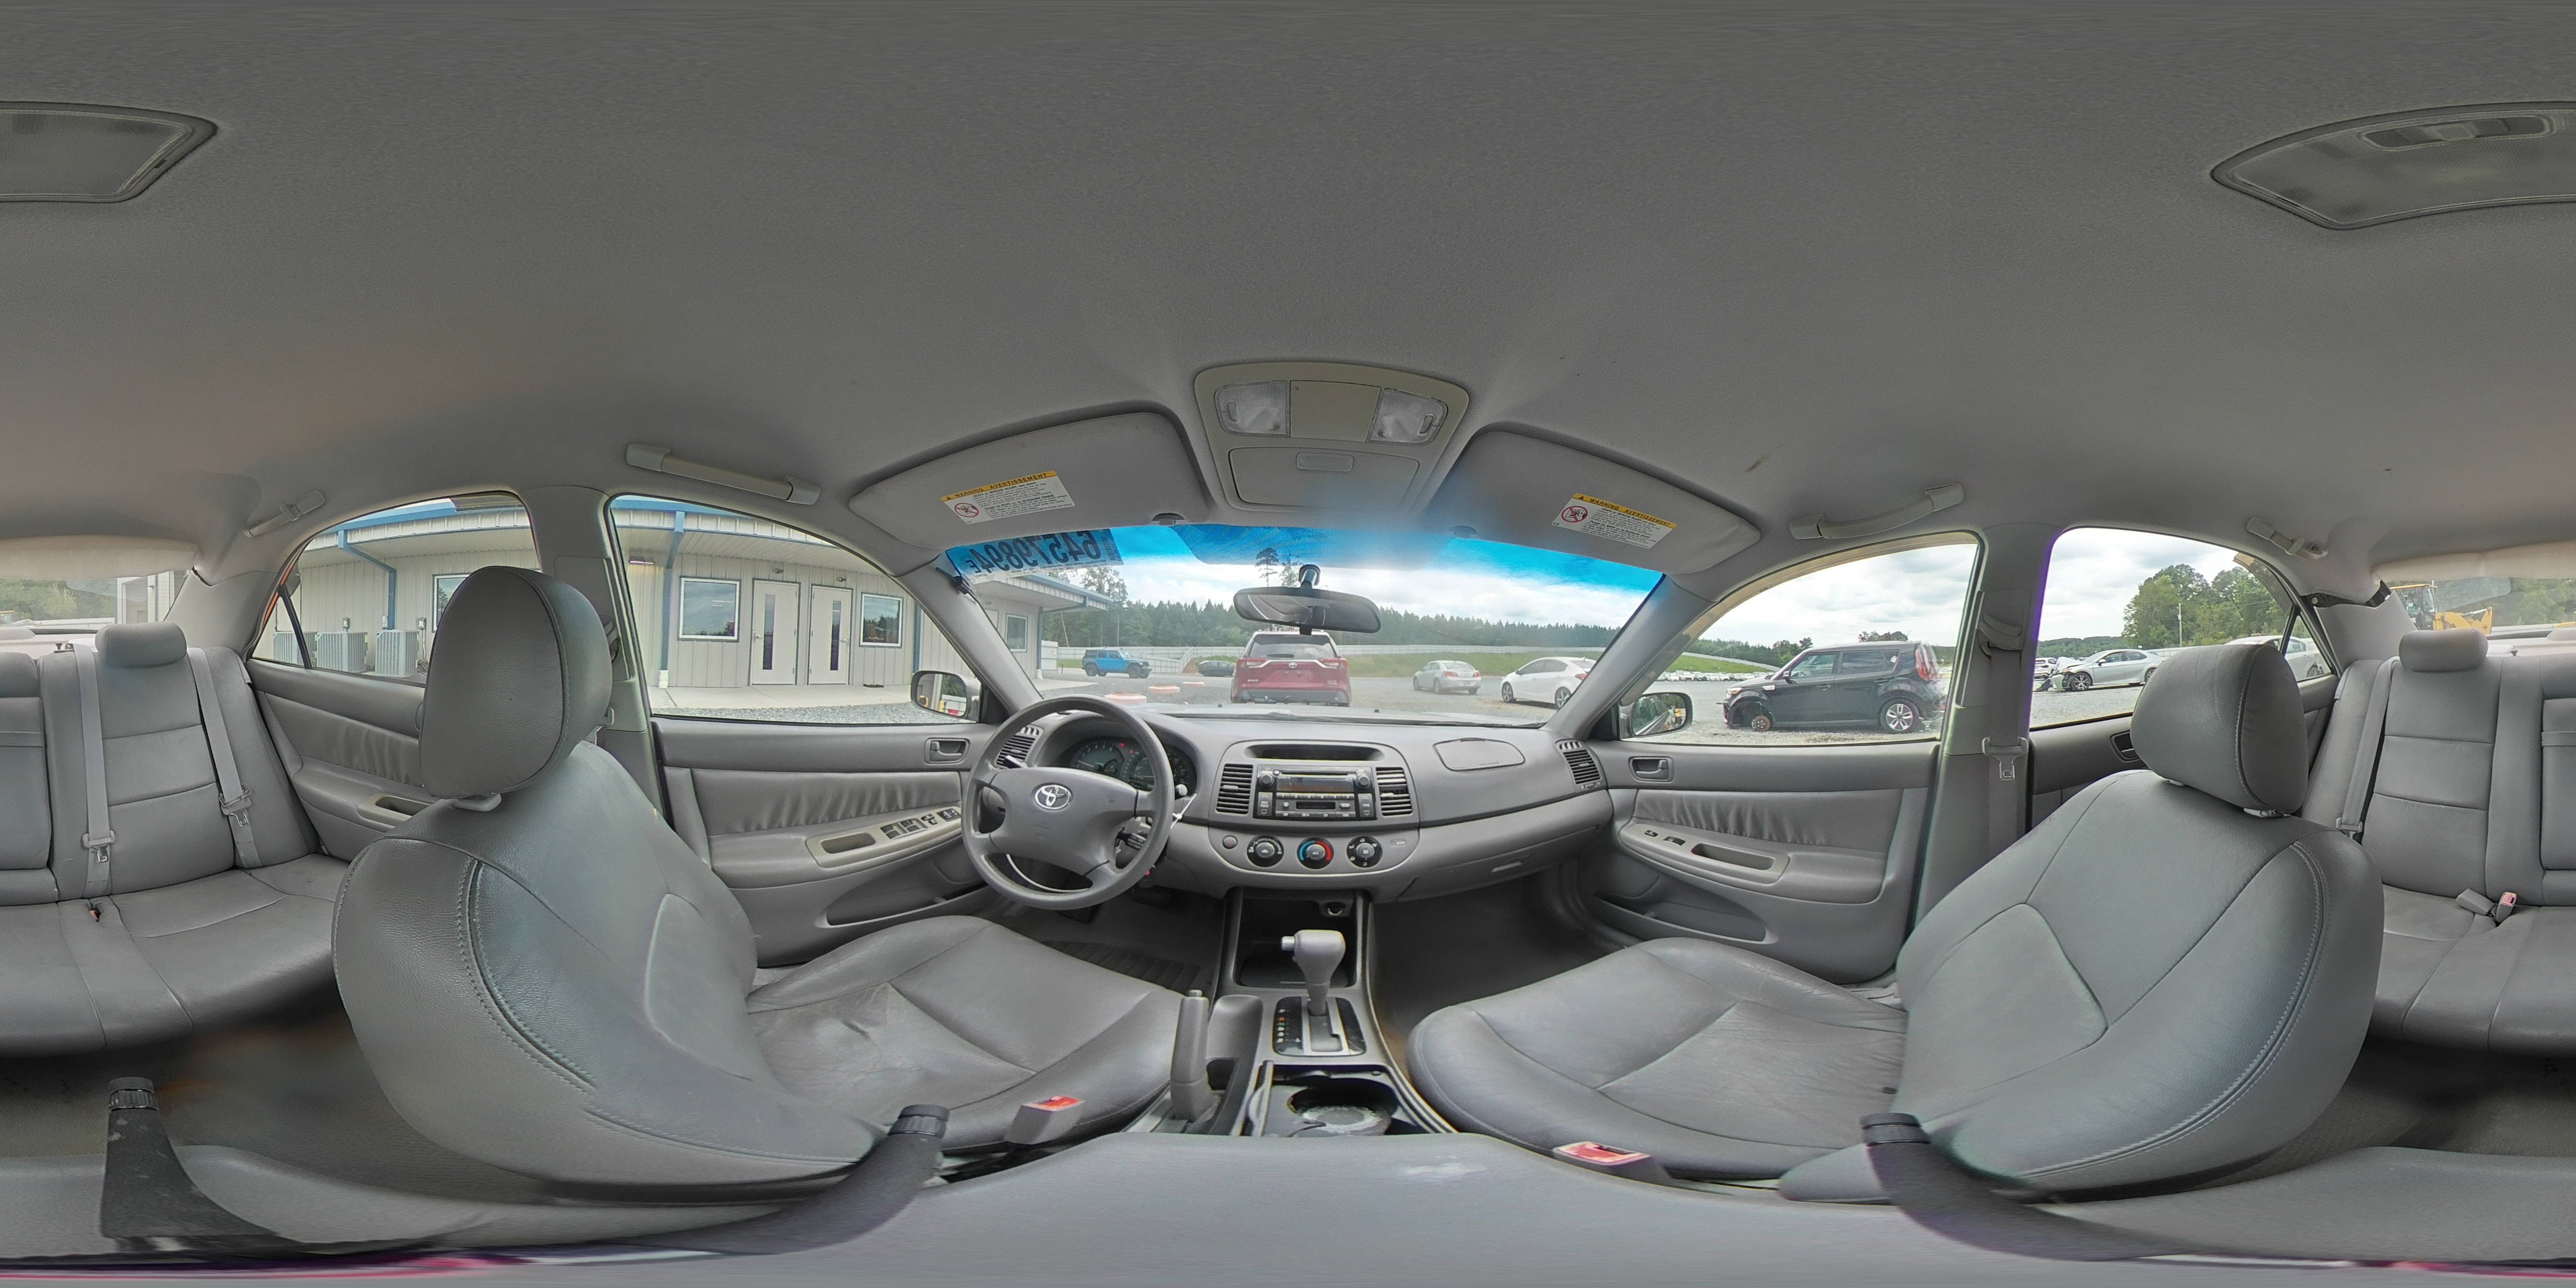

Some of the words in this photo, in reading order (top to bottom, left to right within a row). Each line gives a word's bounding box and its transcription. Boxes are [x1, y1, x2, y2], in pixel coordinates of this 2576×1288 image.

[955, 488, 983, 497] WARNING
[989, 473, 1047, 489] AVERTISSEMENT
[1590, 498, 1619, 510] WARNING
[1624, 509, 1671, 526] AVERTISSEMENT
